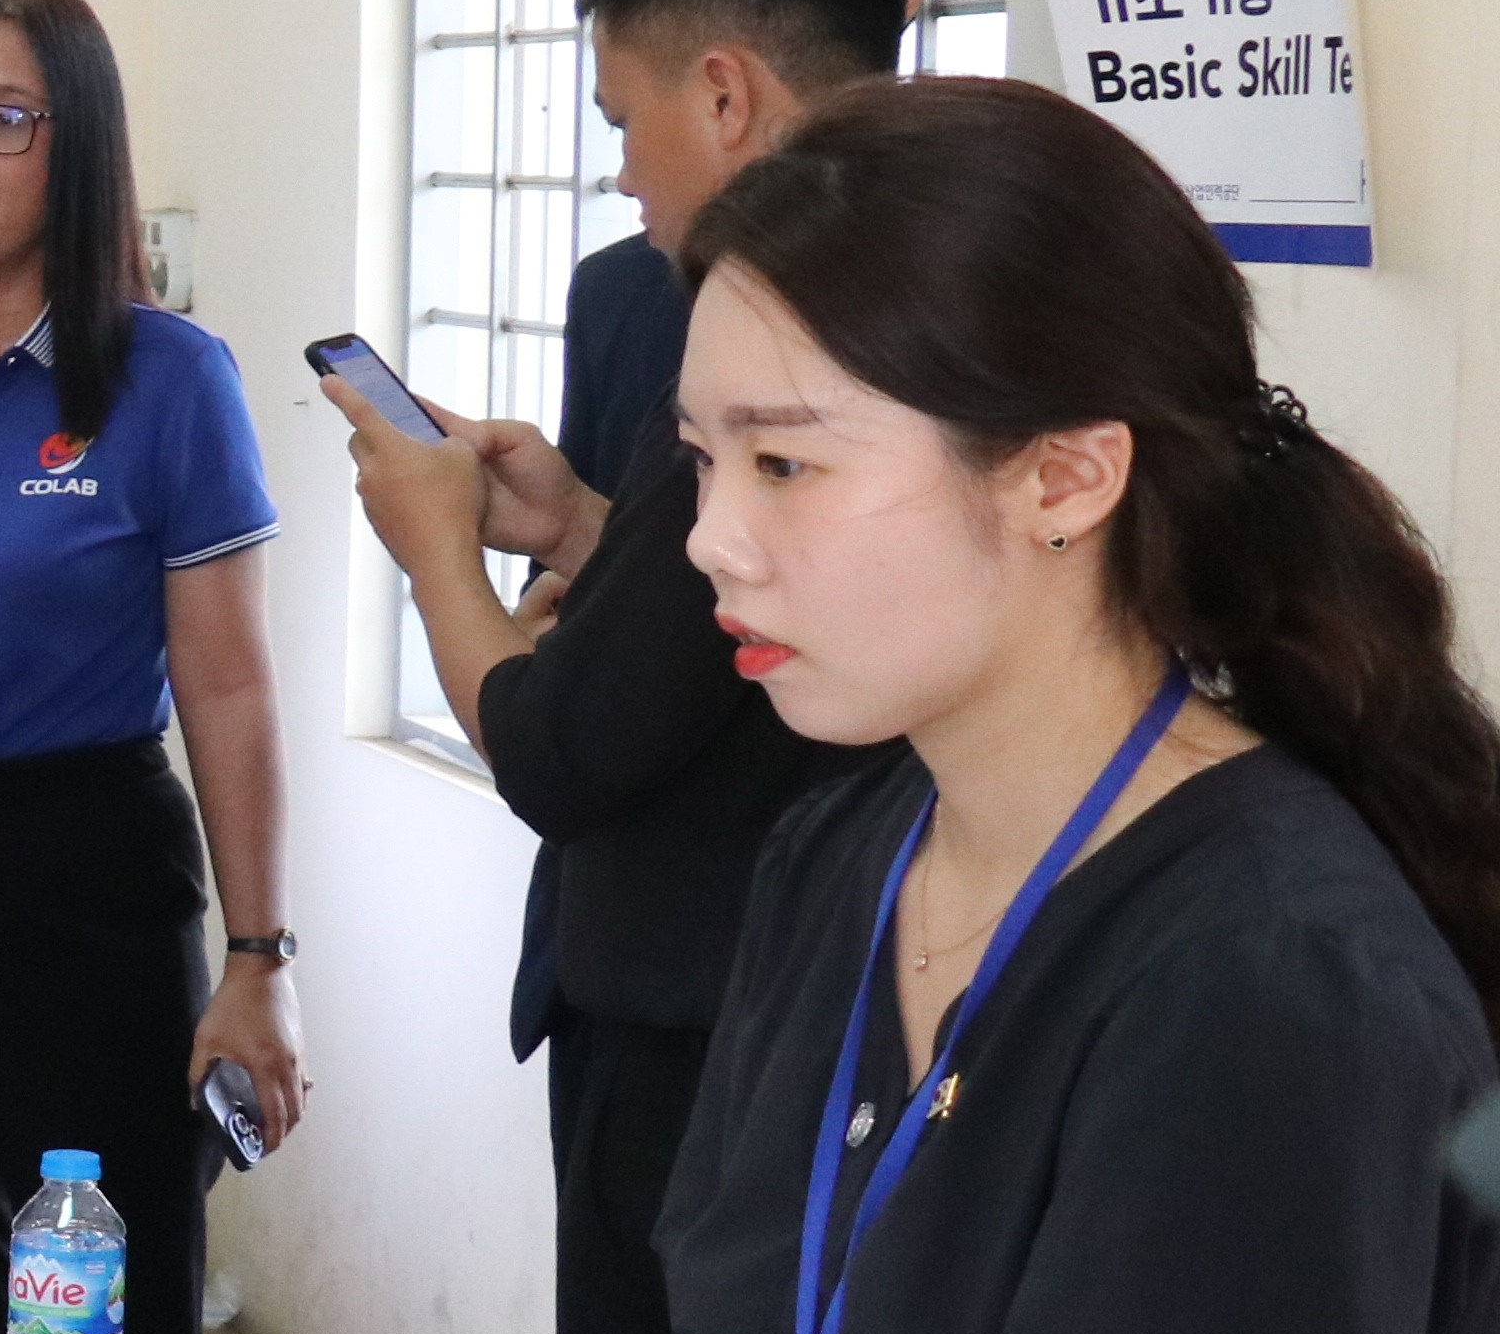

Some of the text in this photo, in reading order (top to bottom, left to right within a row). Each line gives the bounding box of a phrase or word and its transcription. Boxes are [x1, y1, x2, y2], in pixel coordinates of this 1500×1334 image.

[1087, 43, 1222, 103] Basic
[1238, 33, 1312, 97] Skill
[1177, 183, 1241, 202] 산업인력공단
[19, 477, 99, 496] COLAB
